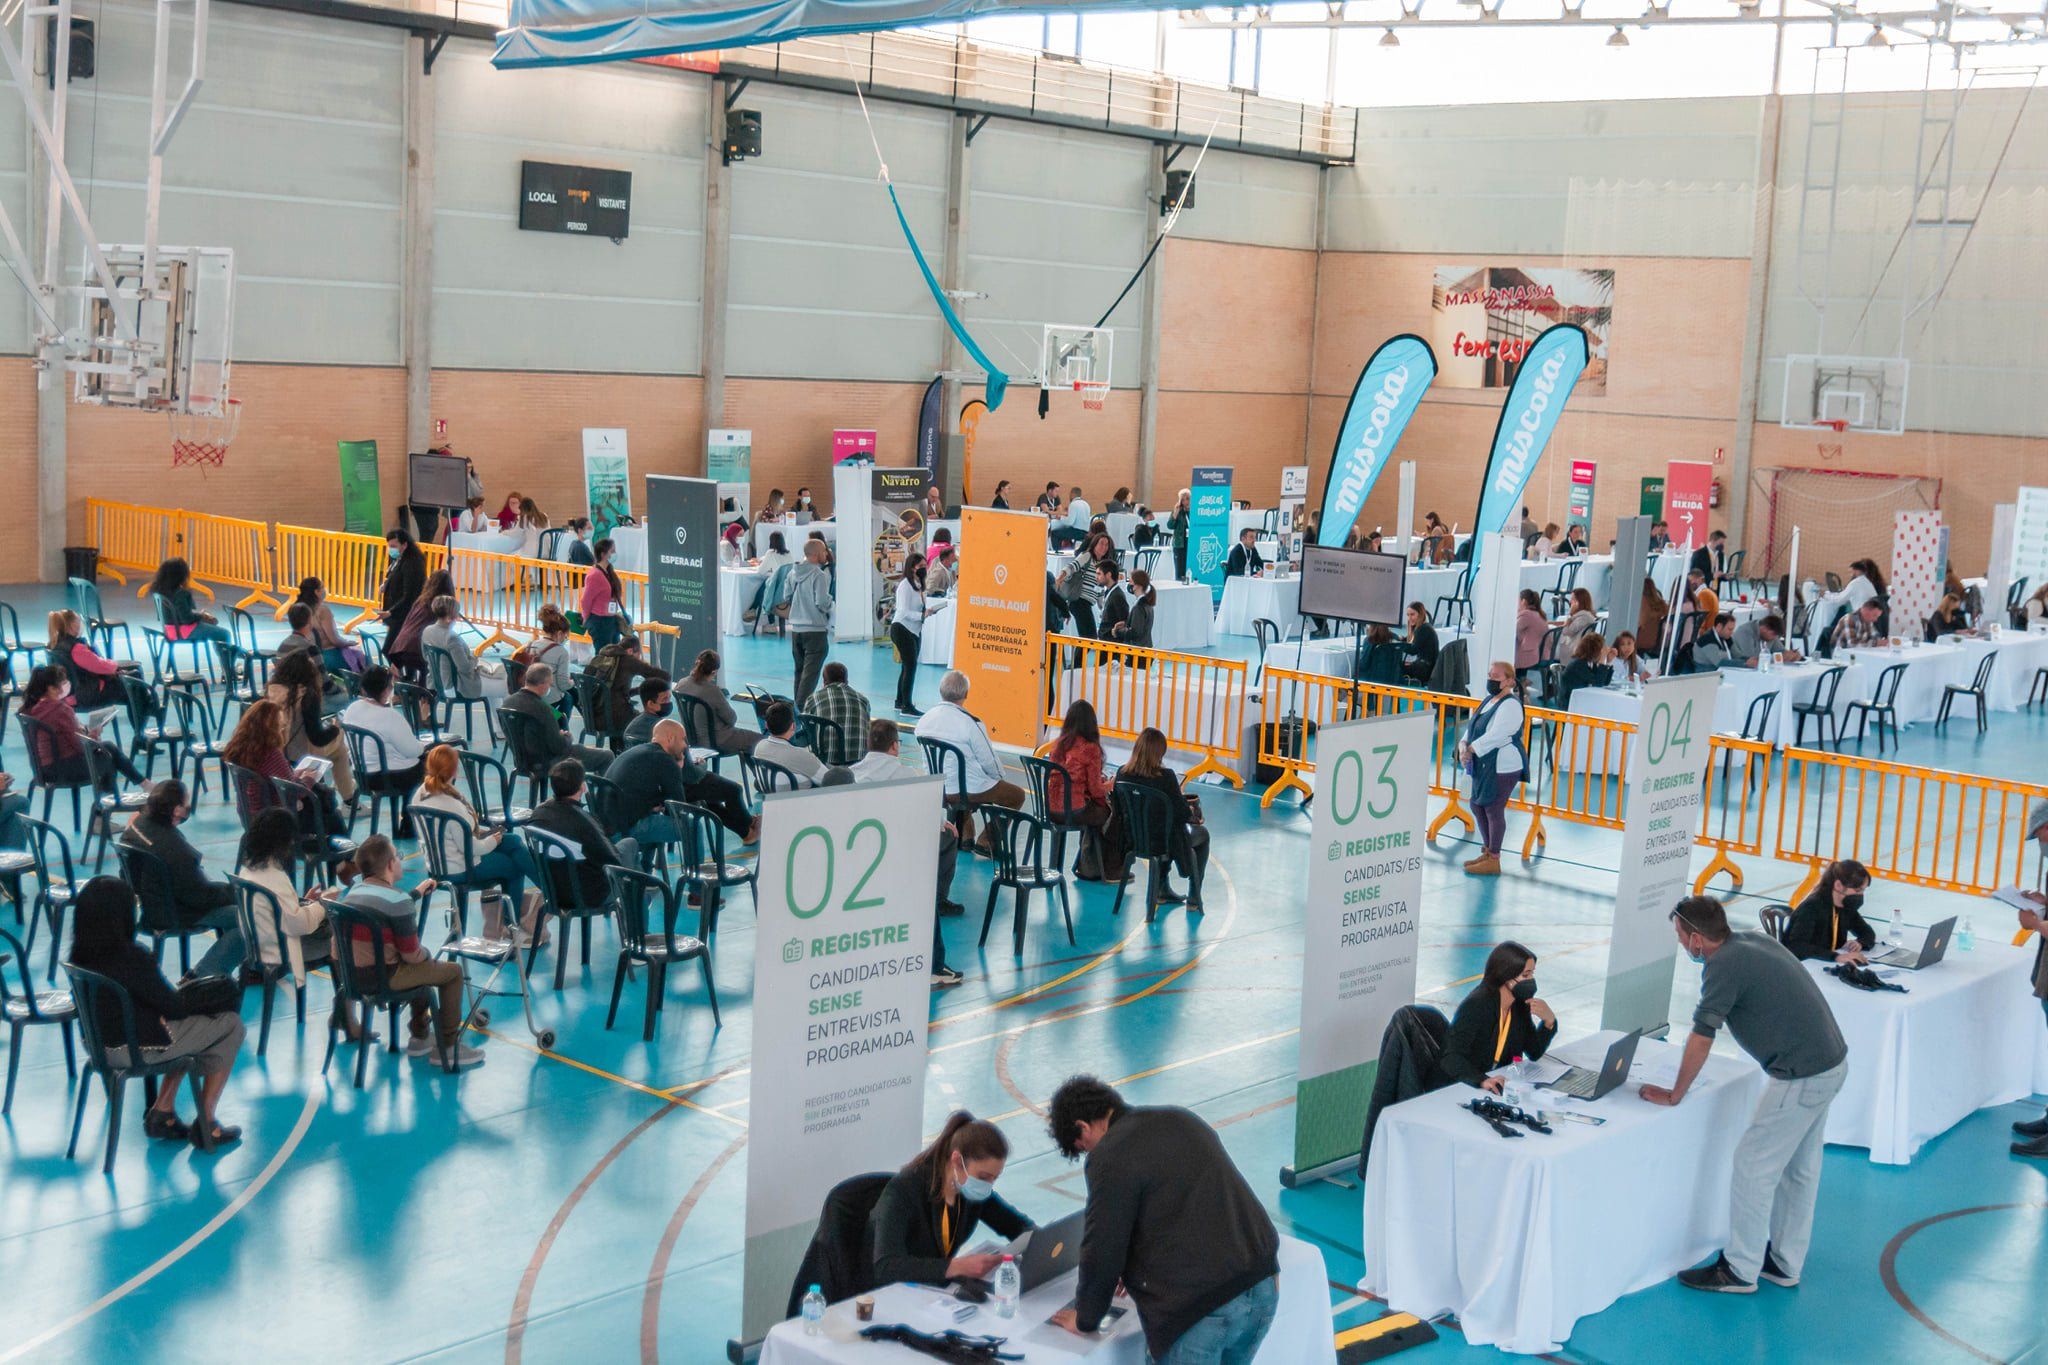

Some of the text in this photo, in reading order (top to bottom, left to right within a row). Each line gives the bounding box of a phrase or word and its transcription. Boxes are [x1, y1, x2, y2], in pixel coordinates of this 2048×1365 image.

[528, 191, 558, 204] LOCAL
[598, 198, 626, 210] VISITANTE
[566, 222, 588, 231] PERIODO
[1445, 284, 1555, 306] MASSANASSA
[1453, 331, 1494, 359] fem
[1494, 347, 1567, 495] miscota
[1334, 360, 1409, 514] miscota
[881, 474, 920, 486] Navarro
[660, 554, 703, 568] ESPERA ACÍ
[970, 595, 1030, 612] ESPERA AQUÍ
[970, 622, 1026, 636] NUESTRO EQUIPO
[977, 632, 1022, 646] ACOMPAÑARÁ
[982, 644, 1022, 656] ENTREVISTA
[1648, 698, 1693, 765] 04
[1332, 744, 1398, 826] 03
[1653, 772, 1696, 792] REGISTRE
[1650, 793, 1700, 814] CANDIDATS/ES
[1648, 816, 1672, 832] SENSE
[1346, 830, 1411, 857] REGISTRE
[1646, 830, 1687, 850] ENTREVISTA
[1643, 846, 1690, 868] PROGRAMADA
[786, 818, 888, 920] 02
[1344, 857, 1421, 884] CANDIDATS/ES
[1344, 885, 1381, 906] SENSE
[1342, 900, 1408, 928] ENTREVISTA
[810, 924, 910, 958] REGISTRE
[1341, 920, 1414, 948] PROGRAMADA
[810, 954, 924, 990] CANDIDATS/ES
[808, 990, 863, 1016] SENSE
[808, 1008, 901, 1042] ENTREVISTA
[806, 1030, 915, 1067] PROGRAMADA
[805, 1076, 912, 1109] REGISTRO CANDIDATOS/AS
[820, 1098, 870, 1118] ENTREVISTA
[804, 1113, 862, 1134] PROGRAMADA
